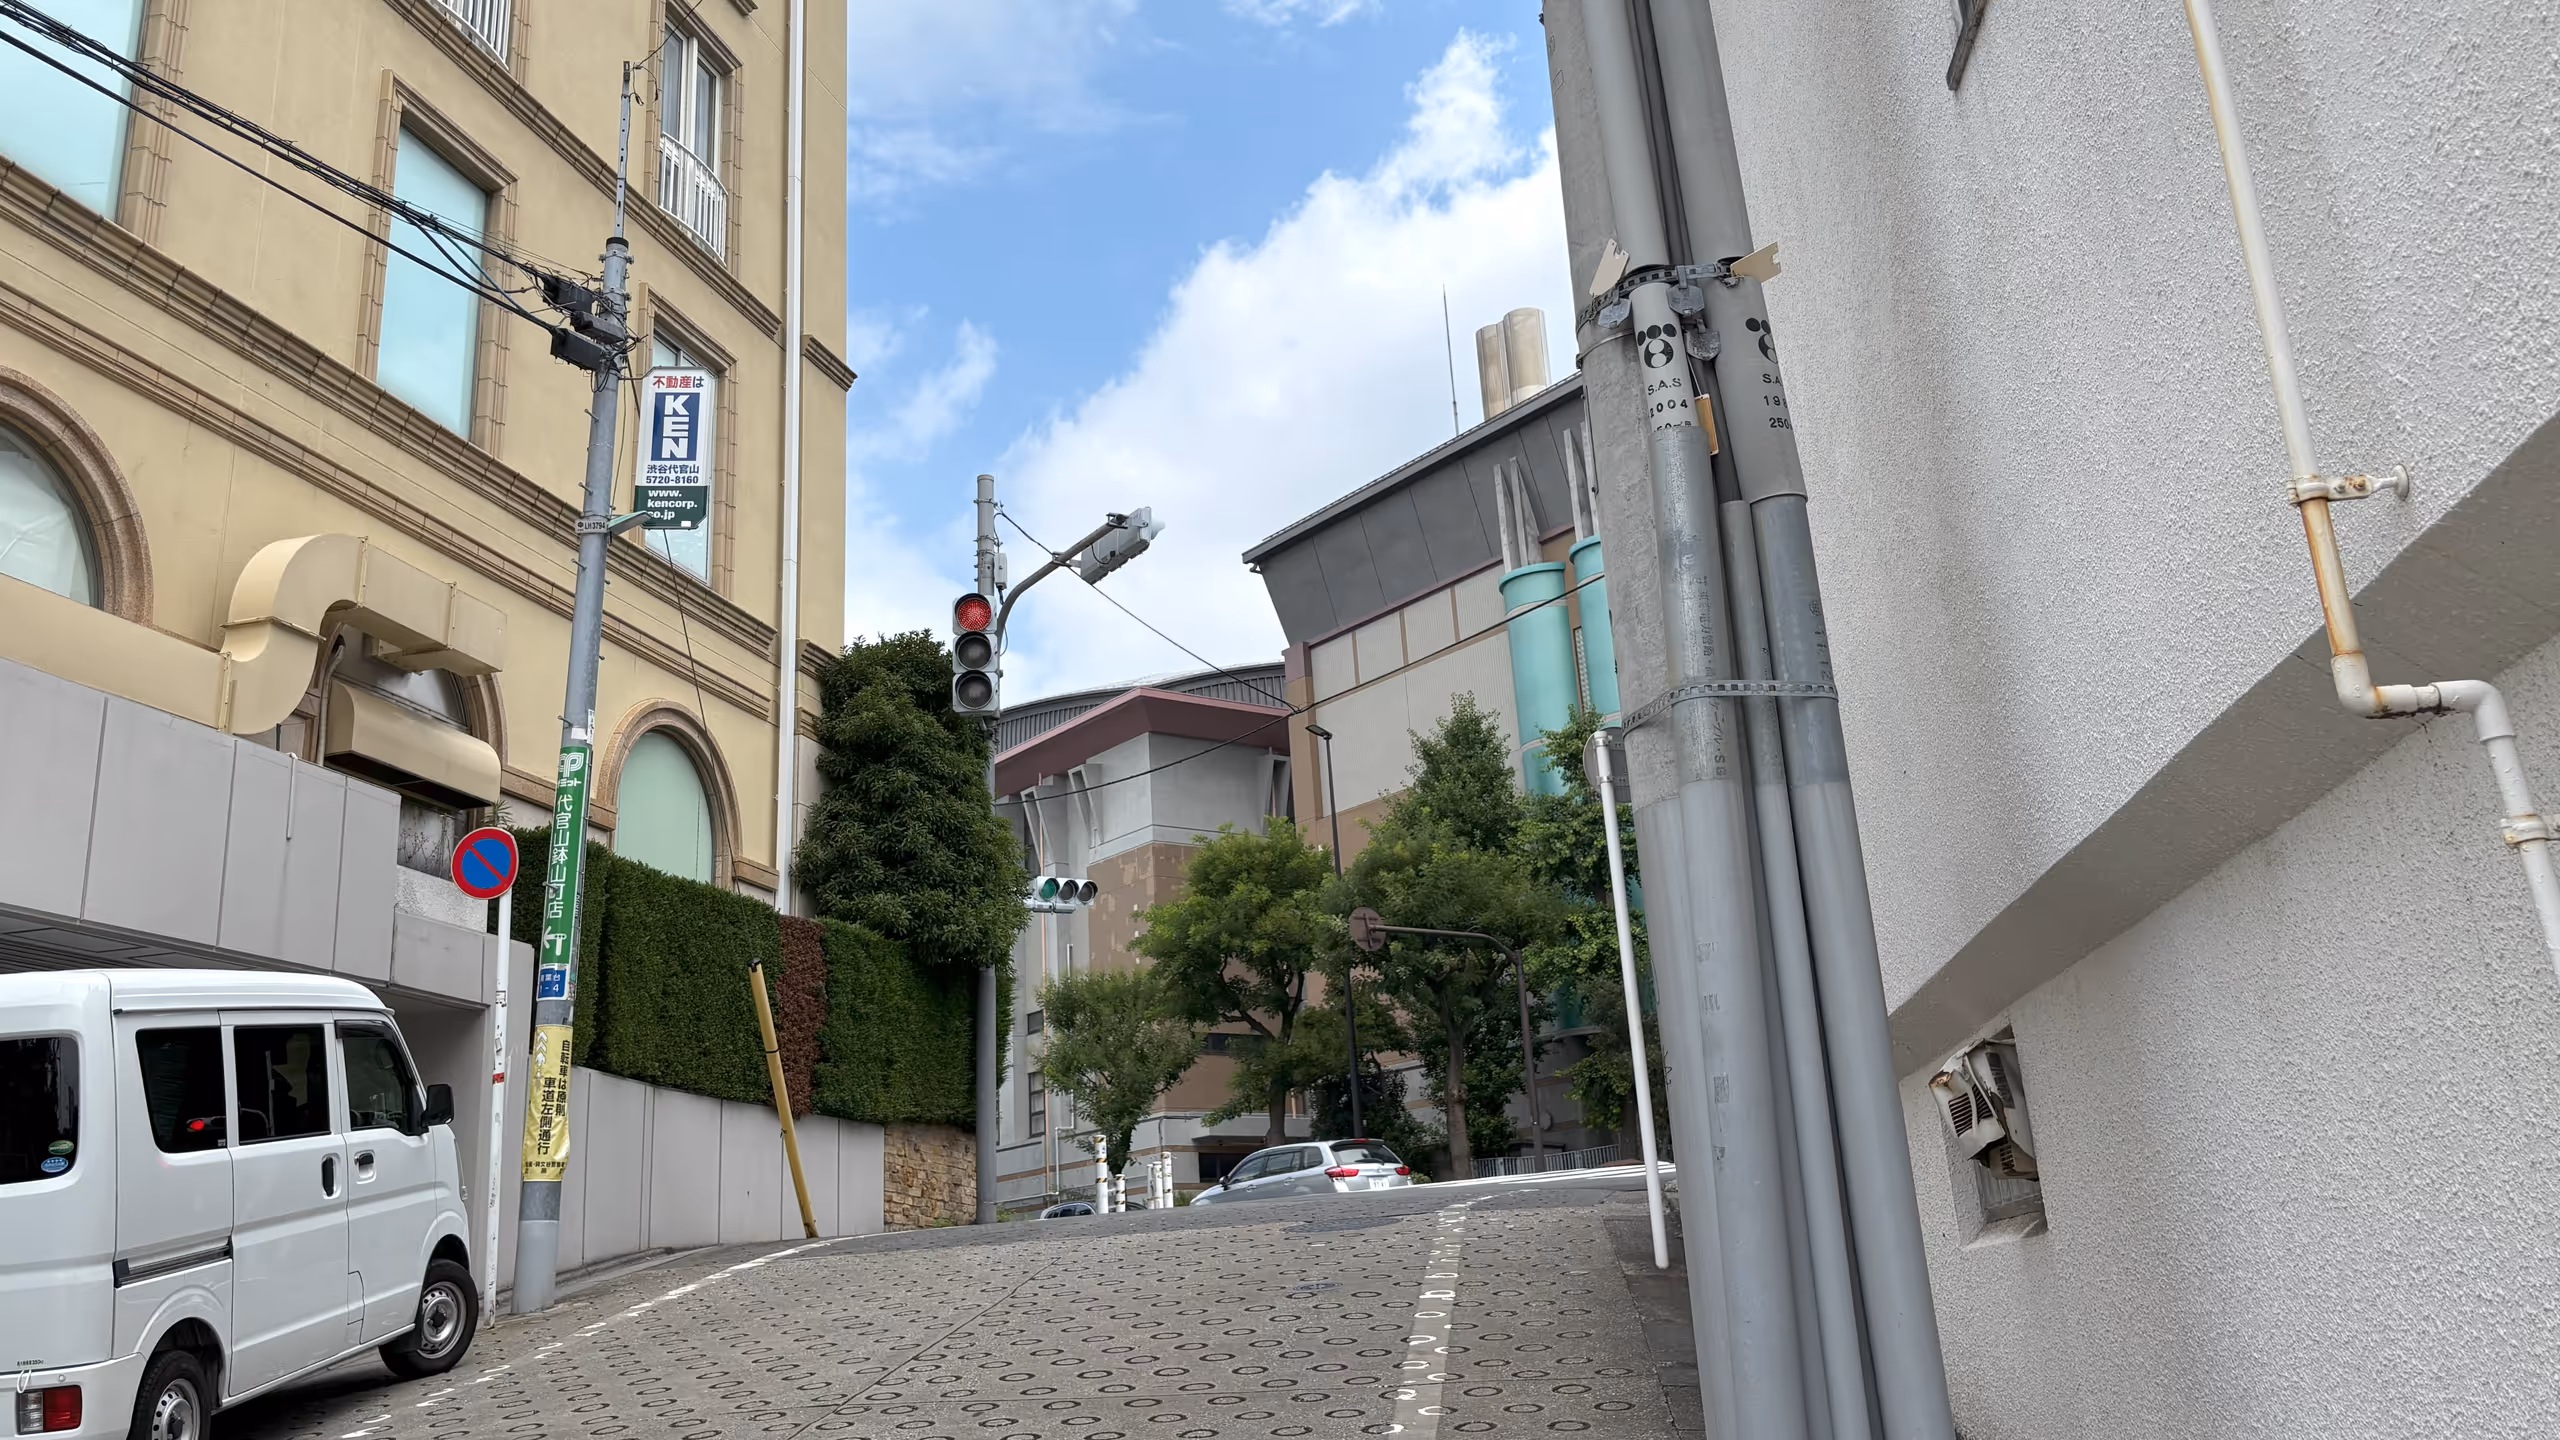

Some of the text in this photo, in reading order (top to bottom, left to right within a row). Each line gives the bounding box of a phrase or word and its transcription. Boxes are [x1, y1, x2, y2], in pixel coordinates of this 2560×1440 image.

[653, 376, 704, 388] 不動産は
[1648, 377, 1682, 396] S.A.S
[661, 394, 690, 459] KEN
[646, 464, 699, 474] 渋谷代官山
[646, 476, 699, 484] 5720-8160
[647, 499, 698, 509] kencorp.
[556, 1039, 570, 1116] 自転車は原則
[537, 1077, 556, 1155] 車道左側通行
